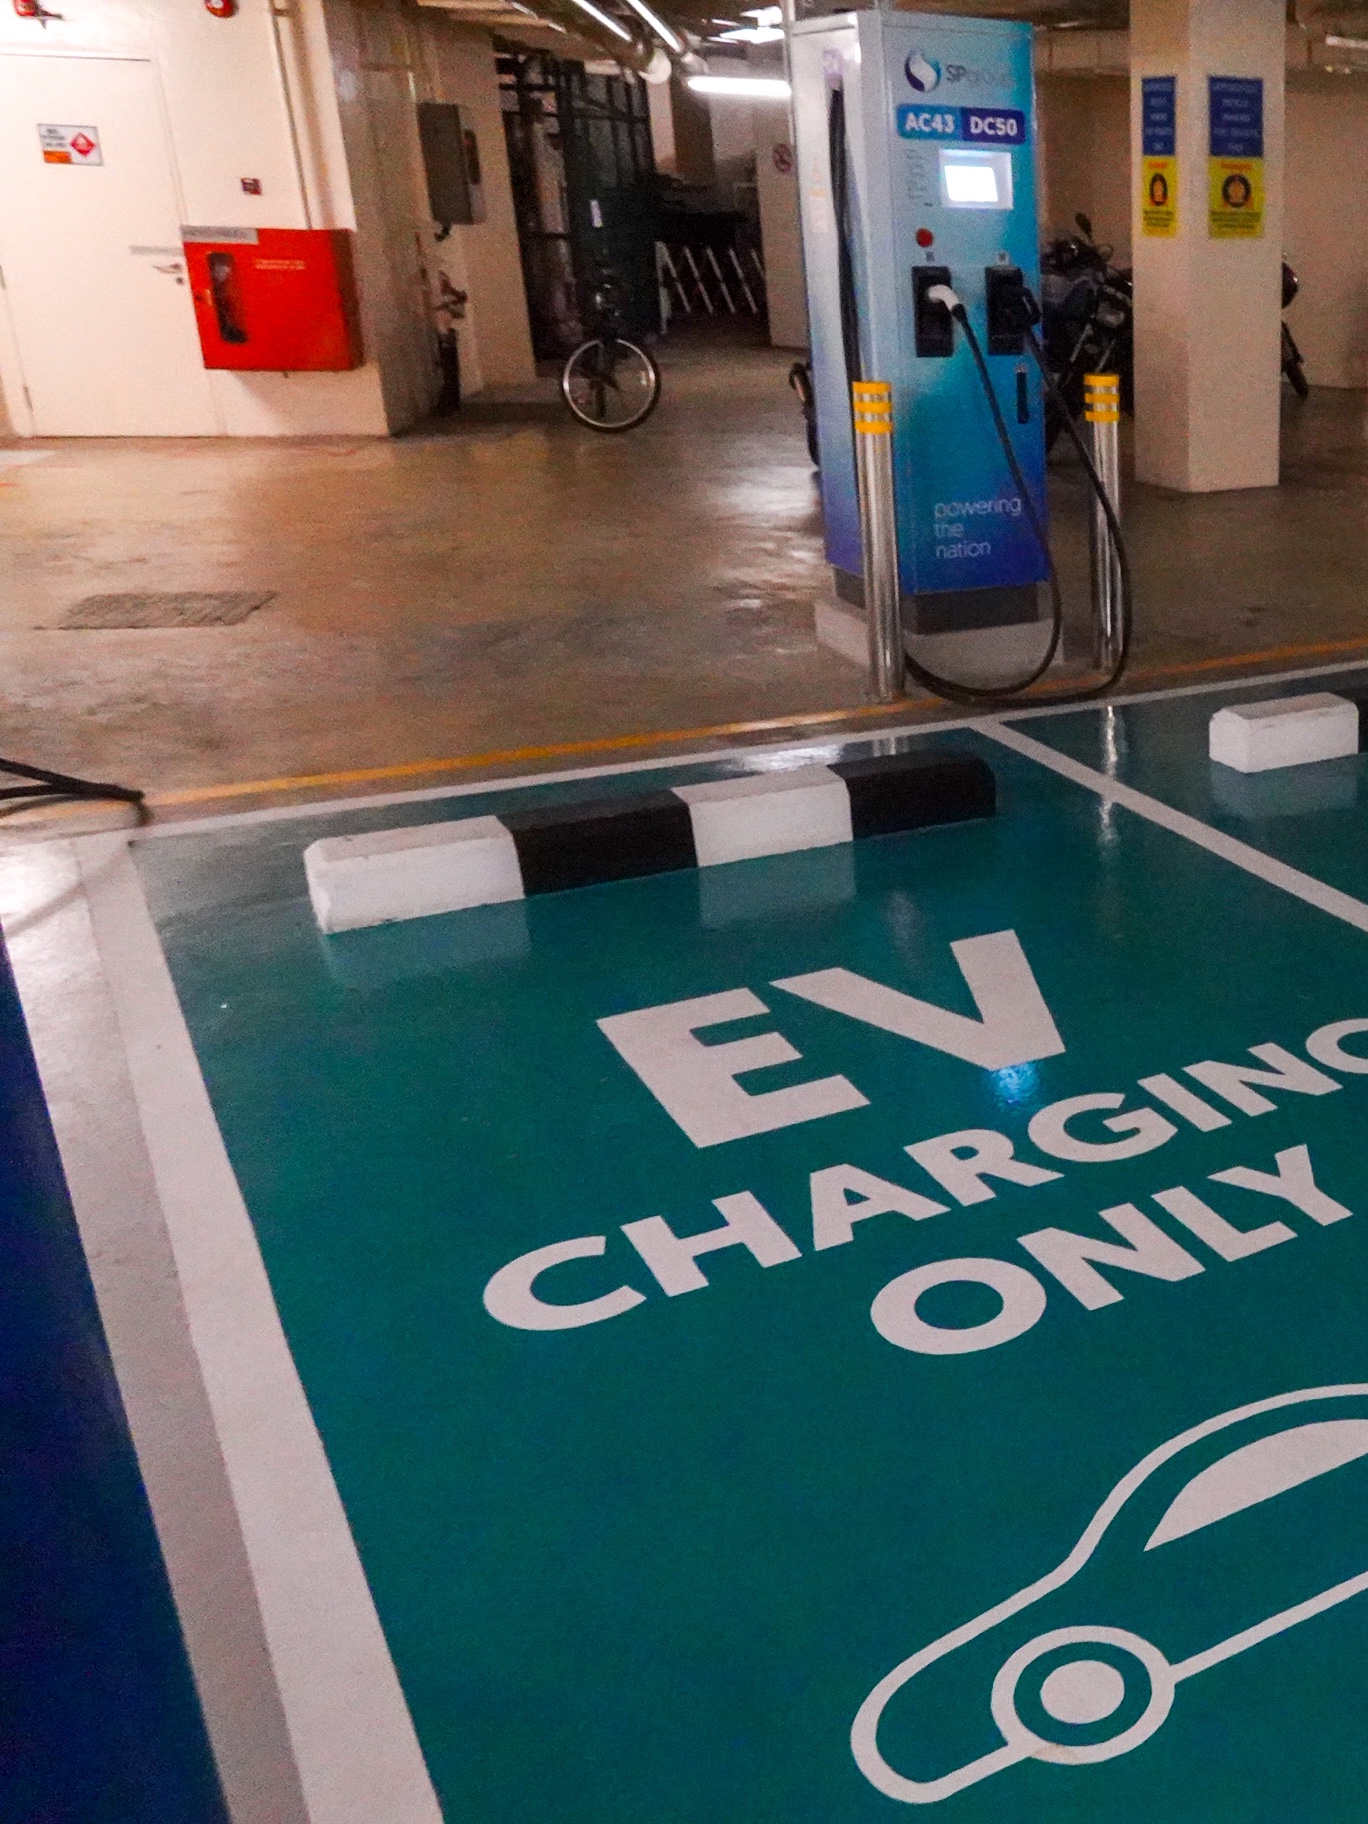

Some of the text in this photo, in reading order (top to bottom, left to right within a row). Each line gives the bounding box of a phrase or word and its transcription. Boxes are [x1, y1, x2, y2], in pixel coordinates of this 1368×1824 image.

[905, 112, 1018, 137] AC43 DC50
[934, 497, 1022, 520] powering
[933, 521, 965, 539] the
[935, 540, 992, 559] nation
[595, 929, 1066, 1148] EV
[870, 1144, 1354, 1355] ONLY
